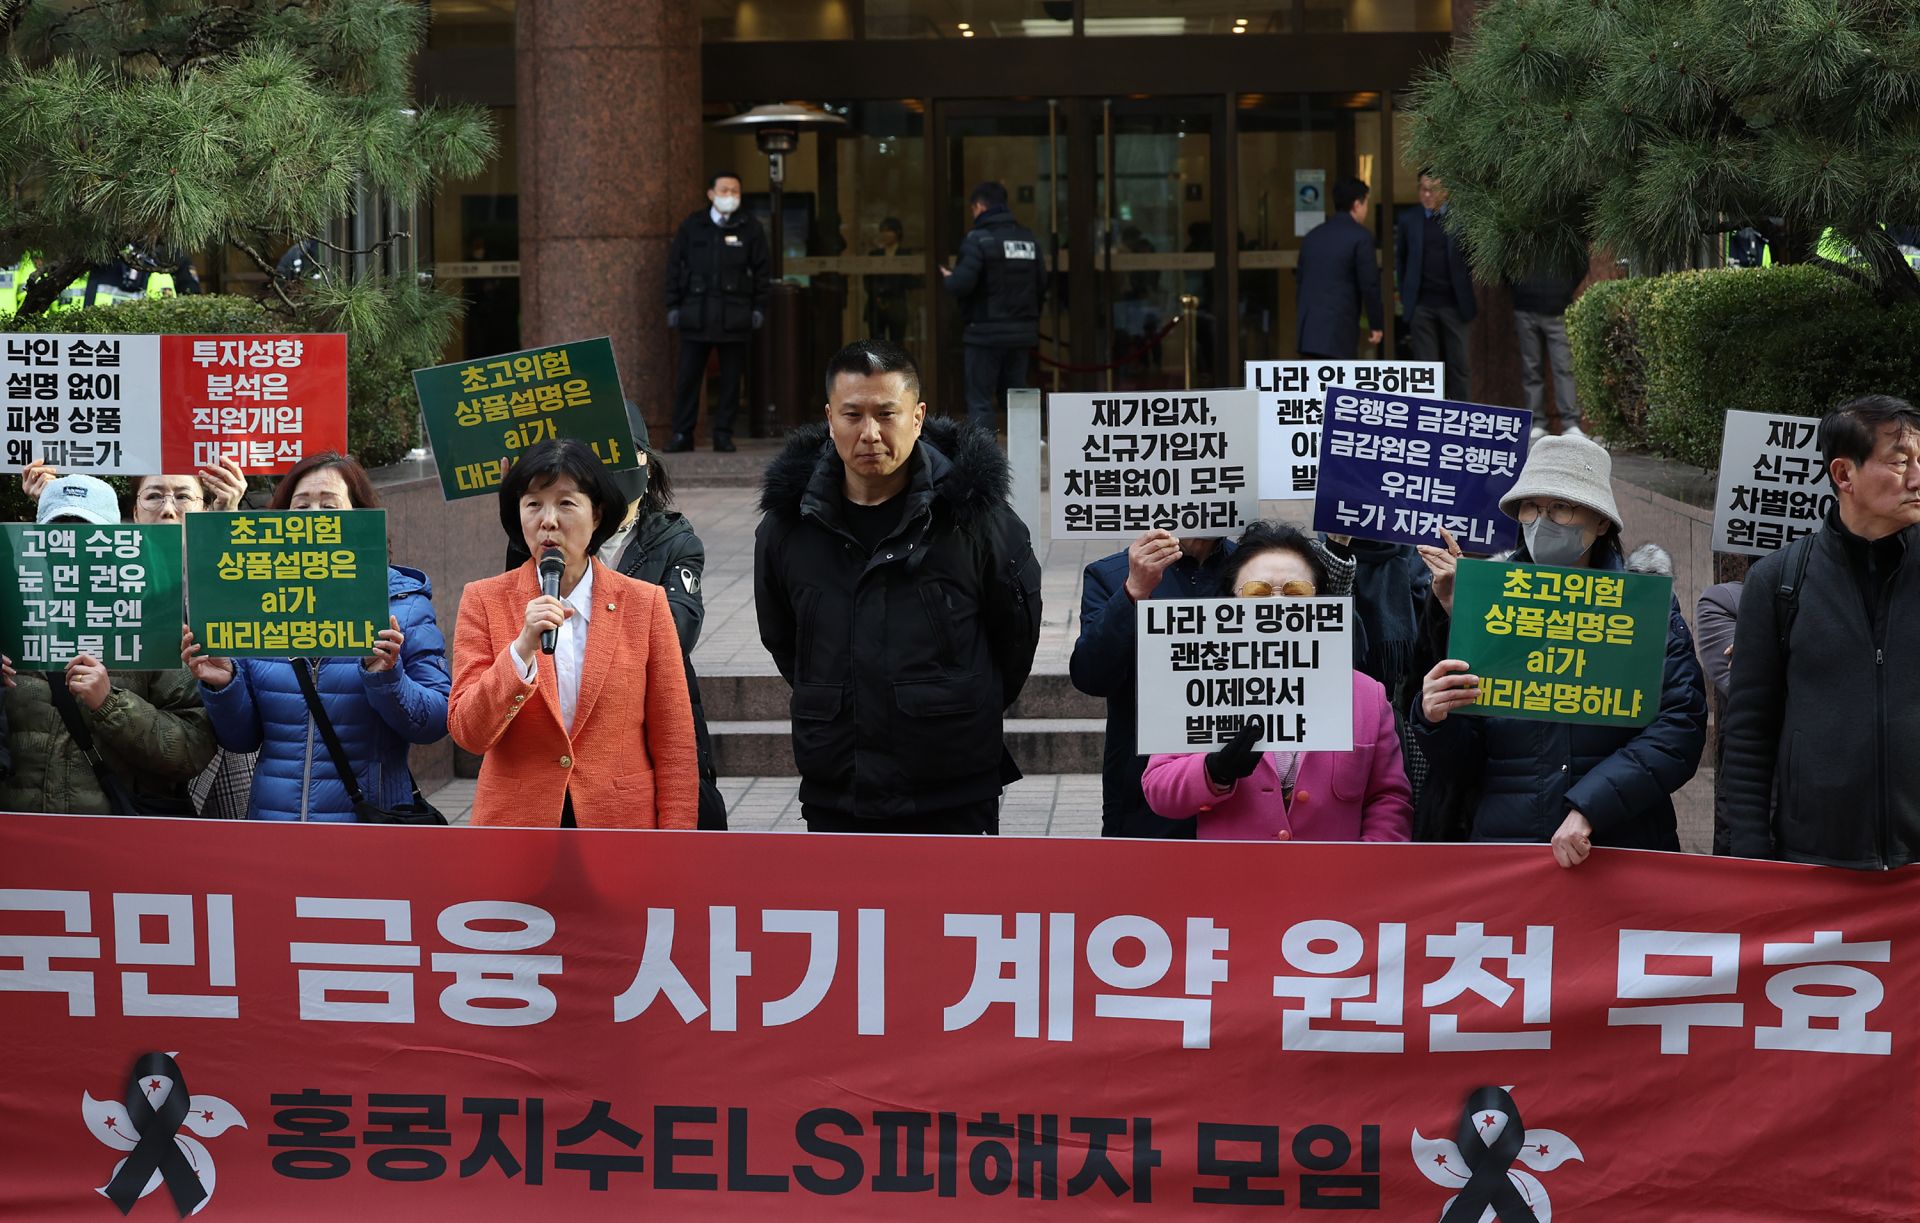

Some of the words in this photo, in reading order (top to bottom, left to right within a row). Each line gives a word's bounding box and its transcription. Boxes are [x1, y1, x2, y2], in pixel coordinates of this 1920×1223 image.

[7, 340, 58, 366] 낙인
[68, 340, 120, 367] 손실
[192, 340, 303, 368] 투자성향
[6, 373, 58, 400] 설명
[68, 373, 120, 401] 없이
[207, 373, 288, 401] 분석은
[460, 350, 572, 393] 초고위험
[1255, 366, 1309, 392] 나라
[1354, 366, 1435, 393] 망하면
[454, 379, 593, 427] 상품설명은
[1091, 397, 1217, 427] 재가입자,
[7, 406, 59, 433] 파생
[68, 406, 121, 434] 상품
[192, 406, 303, 434] 직원개입
[503, 417, 558, 450] ai가
[1334, 395, 1409, 429] 은행은
[1417, 405, 1522, 443] 금감원탓
[7, 440, 32, 466] 왜
[43, 440, 122, 467] 파는가
[194, 440, 302, 467] 대리분석
[1082, 431, 1228, 463] 신규가입자
[1330, 429, 1431, 467] 금감원은
[1439, 443, 1518, 477] 은행탓
[1064, 468, 1180, 497] 차별없이
[1190, 466, 1245, 495] 모두
[1380, 471, 1456, 505] 우리는
[230, 515, 342, 545] 초고위험
[1064, 501, 1245, 532] 원금보상하라.
[1336, 500, 1386, 531] 누가
[1392, 508, 1495, 545] 지켜주나
[22, 529, 75, 558] 고액
[85, 529, 142, 559] 수당
[18, 564, 44, 592] 눈
[53, 564, 79, 592] 먼
[89, 564, 146, 593] 권유
[217, 550, 357, 581] 상품설명은
[261, 586, 316, 614] ai가
[1503, 568, 1625, 608] 초고위험
[22, 599, 76, 627] 고객
[85, 599, 142, 628] 눈엔
[1147, 605, 1206, 635] 나라
[1215, 604, 1246, 634] 안
[1255, 603, 1344, 633] 망하면
[1484, 604, 1635, 645] 상품설명은
[22, 635, 104, 662] 피눈물
[115, 635, 142, 662] 나
[206, 620, 374, 649] 대리설명하냐
[1170, 640, 1319, 671] 괜찮다더니
[1526, 647, 1586, 678] ai가
[1186, 677, 1305, 707] 이제와서
[1186, 713, 1306, 745] 발뺌이냐
[0, 888, 239, 1019] 국민
[290, 896, 563, 1027] 금융
[613, 905, 885, 1036] 사기
[943, 911, 1229, 1049] 계약
[1273, 919, 1554, 1054] 원천
[1608, 928, 1892, 1055] 무효
[267, 1088, 1162, 1204] 홍콩지수ELS피해자
[1193, 1121, 1381, 1210] 모임
